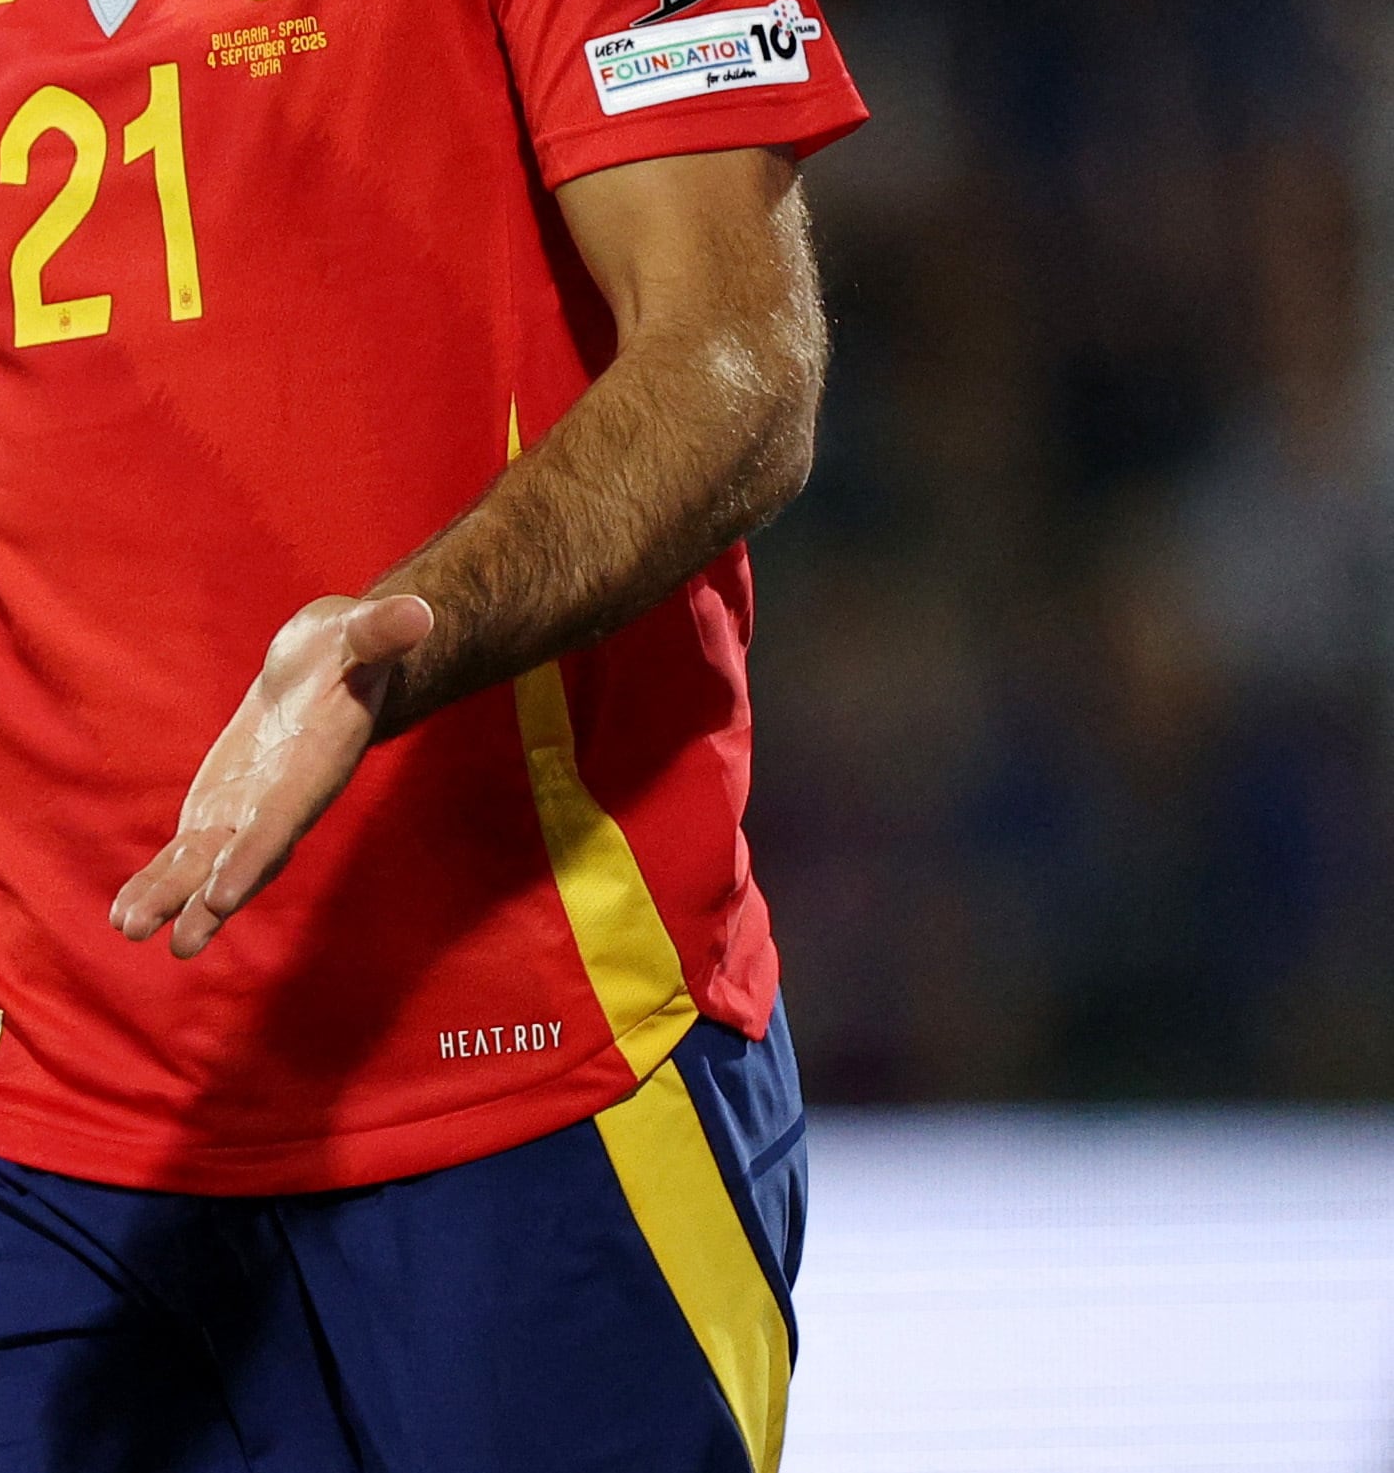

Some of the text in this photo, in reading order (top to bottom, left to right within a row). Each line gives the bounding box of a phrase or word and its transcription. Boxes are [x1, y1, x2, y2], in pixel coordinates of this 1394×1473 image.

[207, 31, 328, 69] 4 SEPTEMBER 2025
[211, 25, 270, 51] BULGARIA
[278, 15, 318, 37] SPAIN
[595, 38, 635, 58] UEFA
[750, 22, 797, 61] 10
[250, 57, 282, 78] SOFIA
[600, 38, 751, 85] FOUNDATION
[706, 67, 757, 88] for children
[439, 1020, 562, 1059] HEAT.RDY
